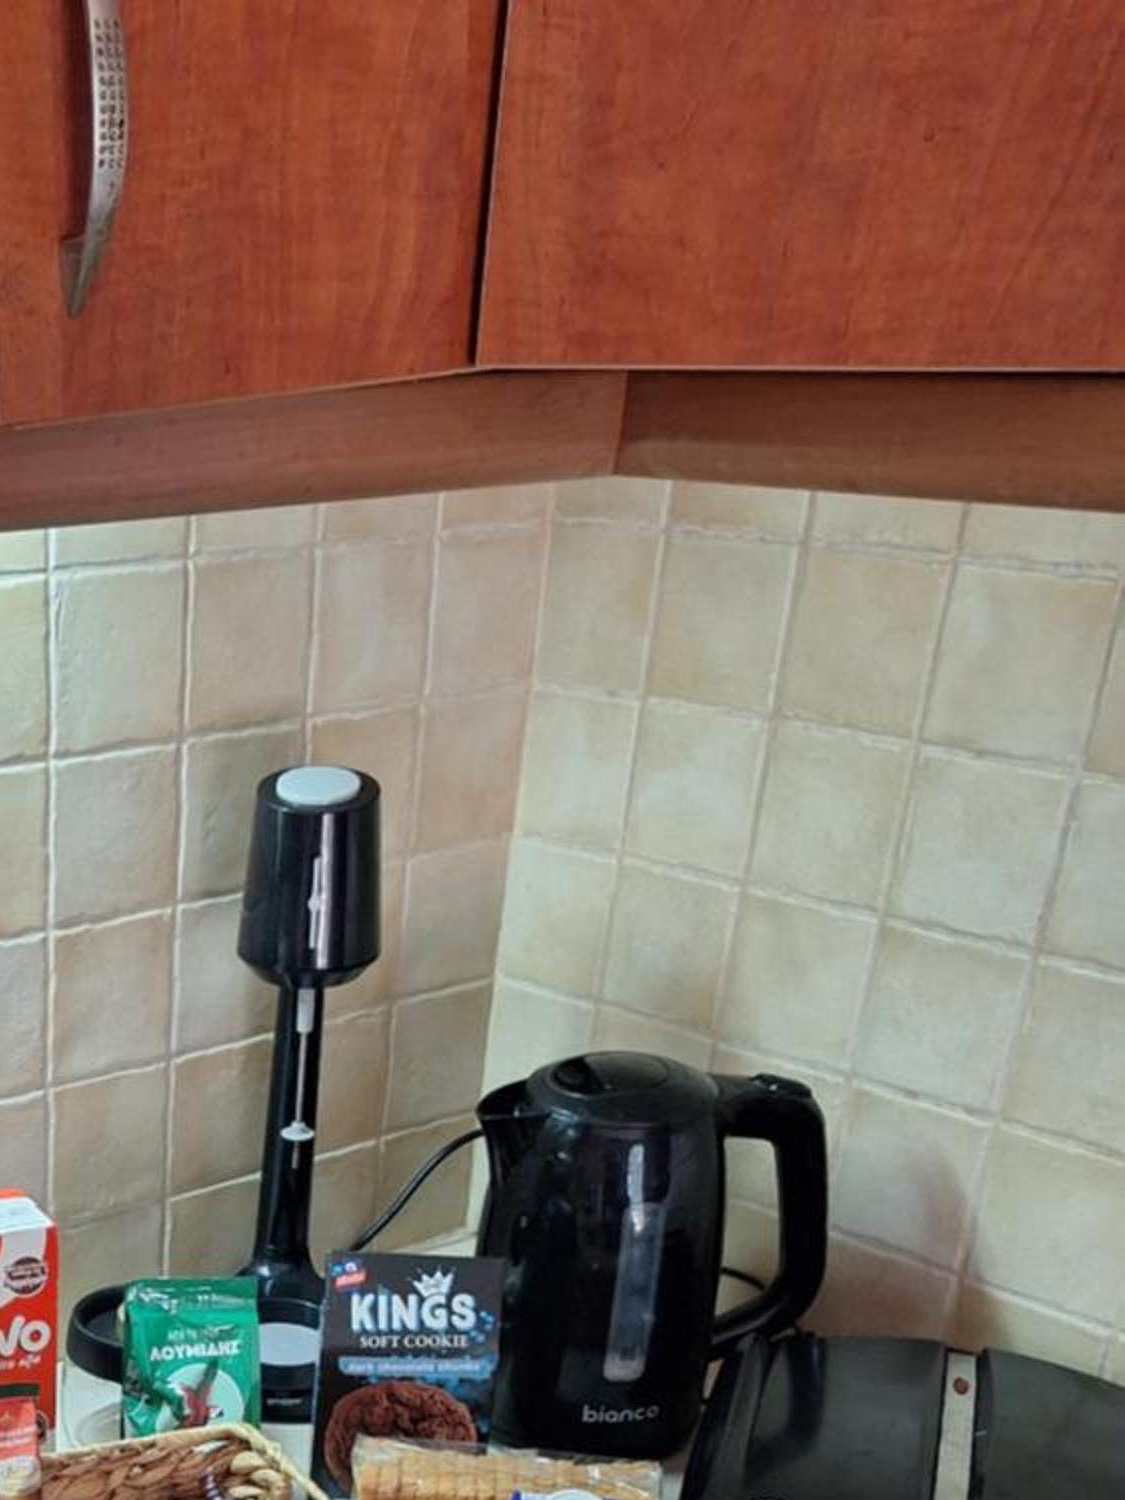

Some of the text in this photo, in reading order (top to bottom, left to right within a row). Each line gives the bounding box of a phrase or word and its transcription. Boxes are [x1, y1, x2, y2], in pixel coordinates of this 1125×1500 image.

[351, 1293, 476, 1333] KINGS
[149, 1339, 242, 1361] ΛΟΥΜΙΔΗΣ
[360, 1334, 469, 1348] SOFT COOKIE
[582, 1404, 659, 1423] bianco
